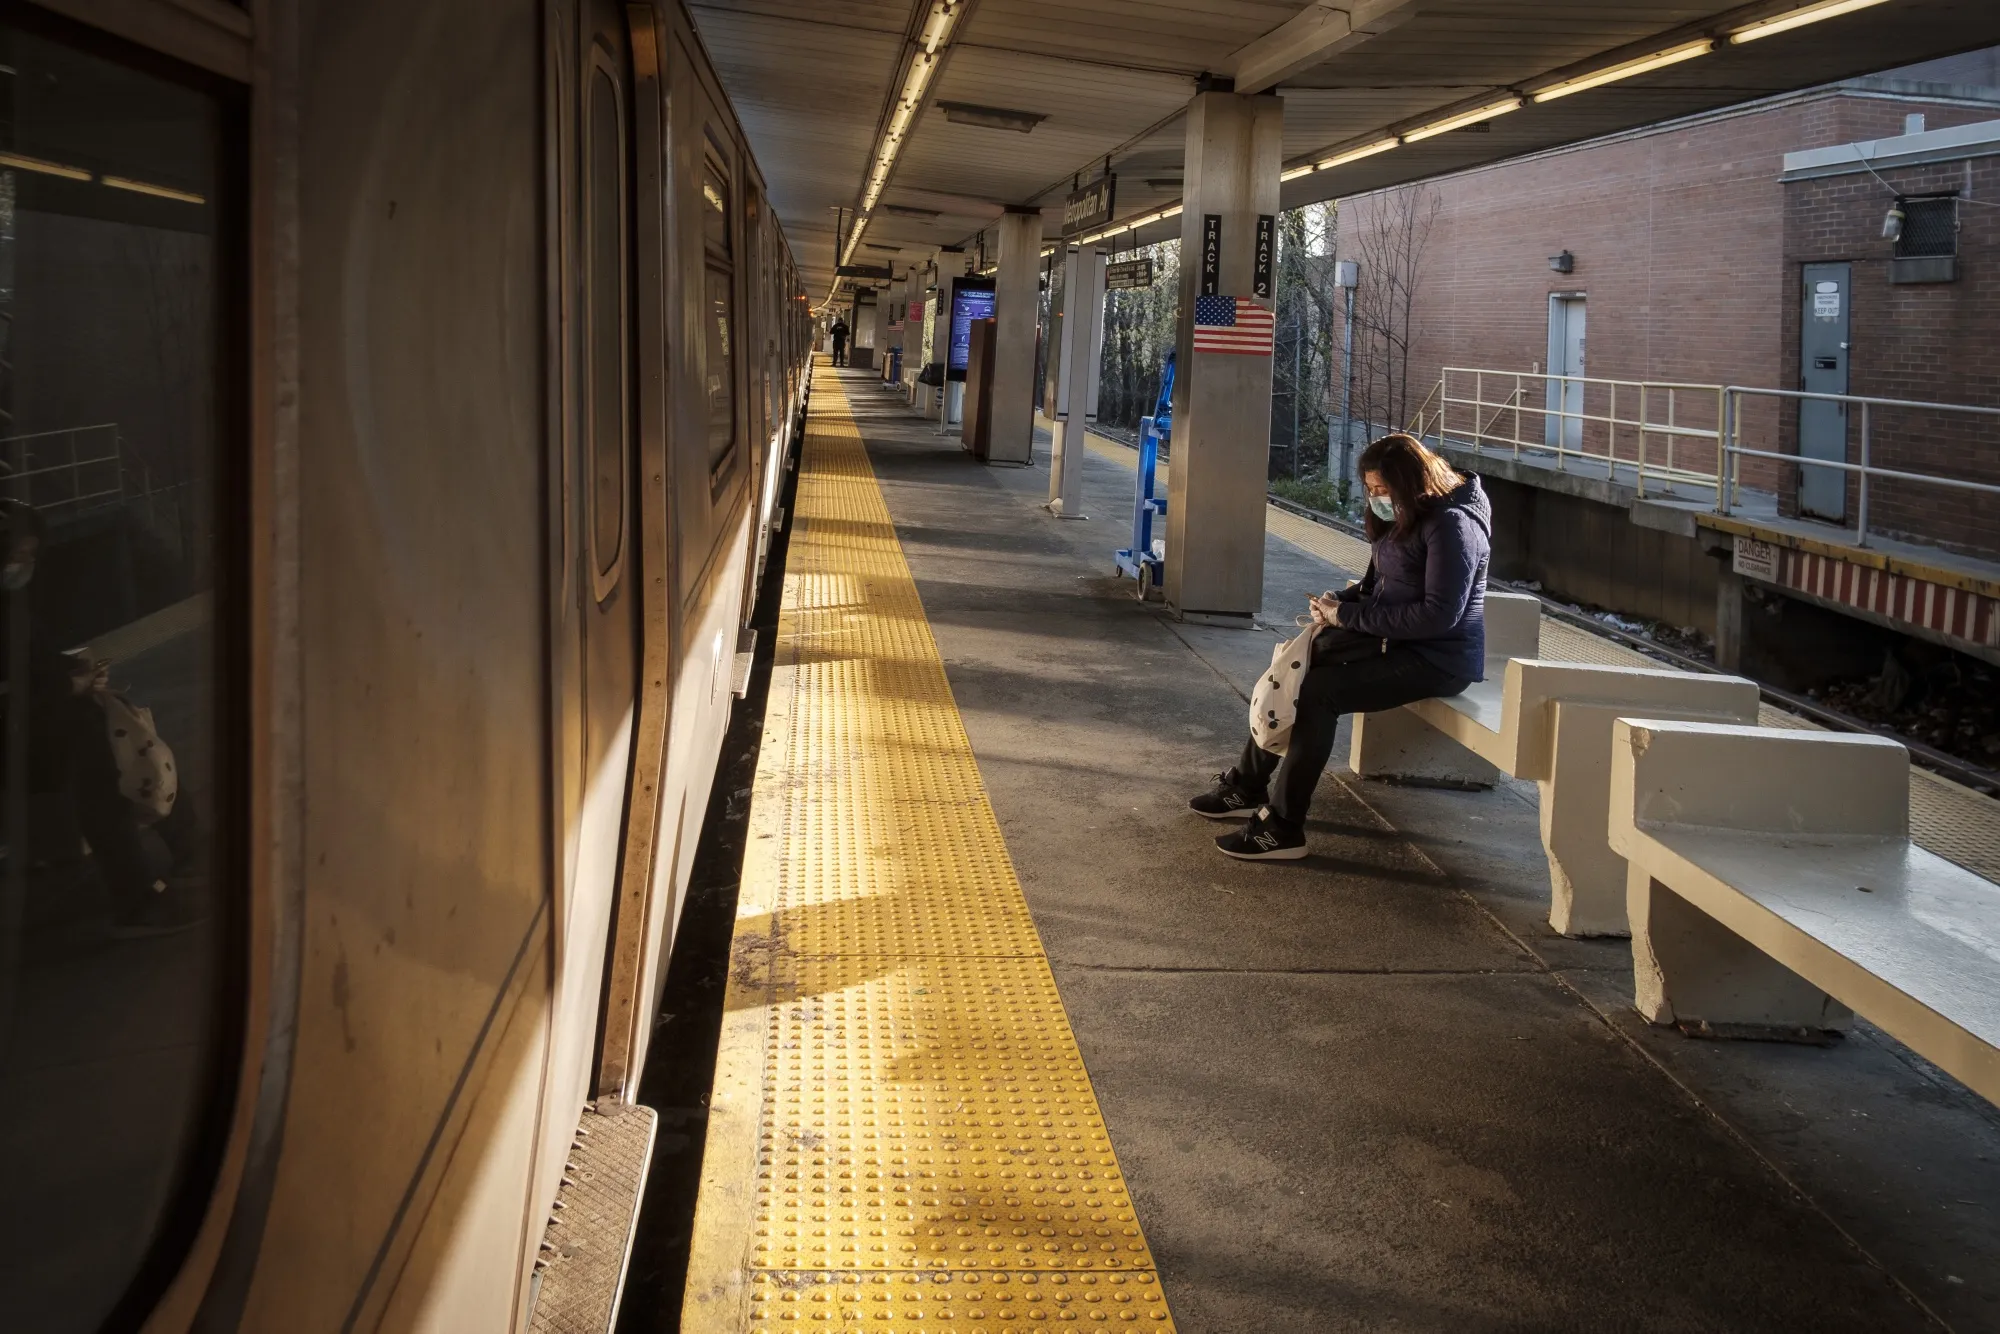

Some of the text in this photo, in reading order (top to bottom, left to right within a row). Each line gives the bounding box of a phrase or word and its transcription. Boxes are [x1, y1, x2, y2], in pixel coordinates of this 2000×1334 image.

[1064, 184, 1109, 227] Metropolitan Av
[1206, 220, 1216, 294] TRACK 1
[1257, 220, 1269, 294] TRACK 2
[1738, 539, 1771, 560] DANGER
